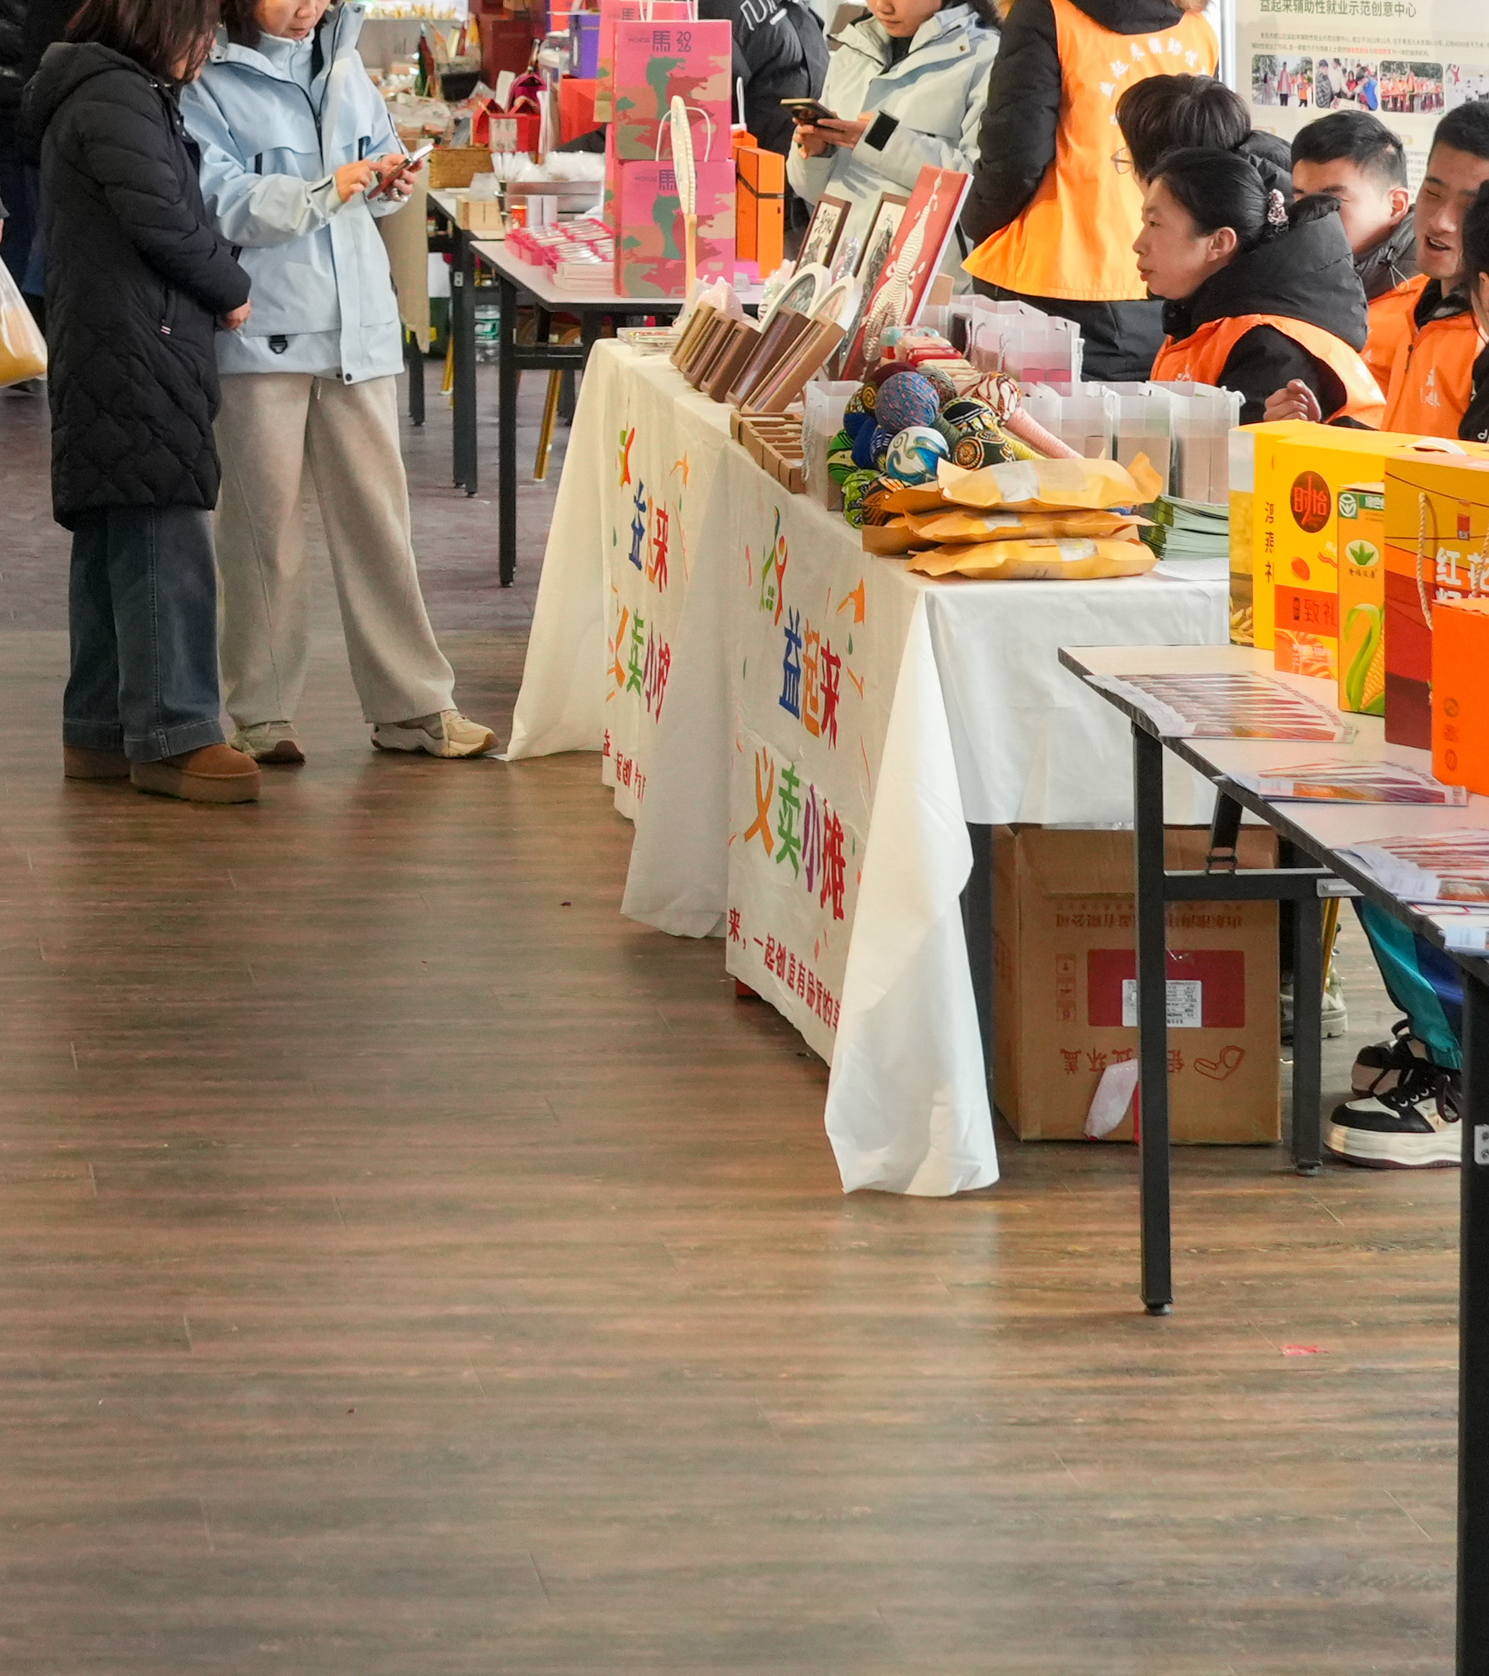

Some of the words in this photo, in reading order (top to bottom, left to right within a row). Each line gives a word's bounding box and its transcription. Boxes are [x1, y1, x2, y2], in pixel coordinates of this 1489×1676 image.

[779, 608, 843, 750] 益起来
[744, 746, 846, 922] 义卖小摊
